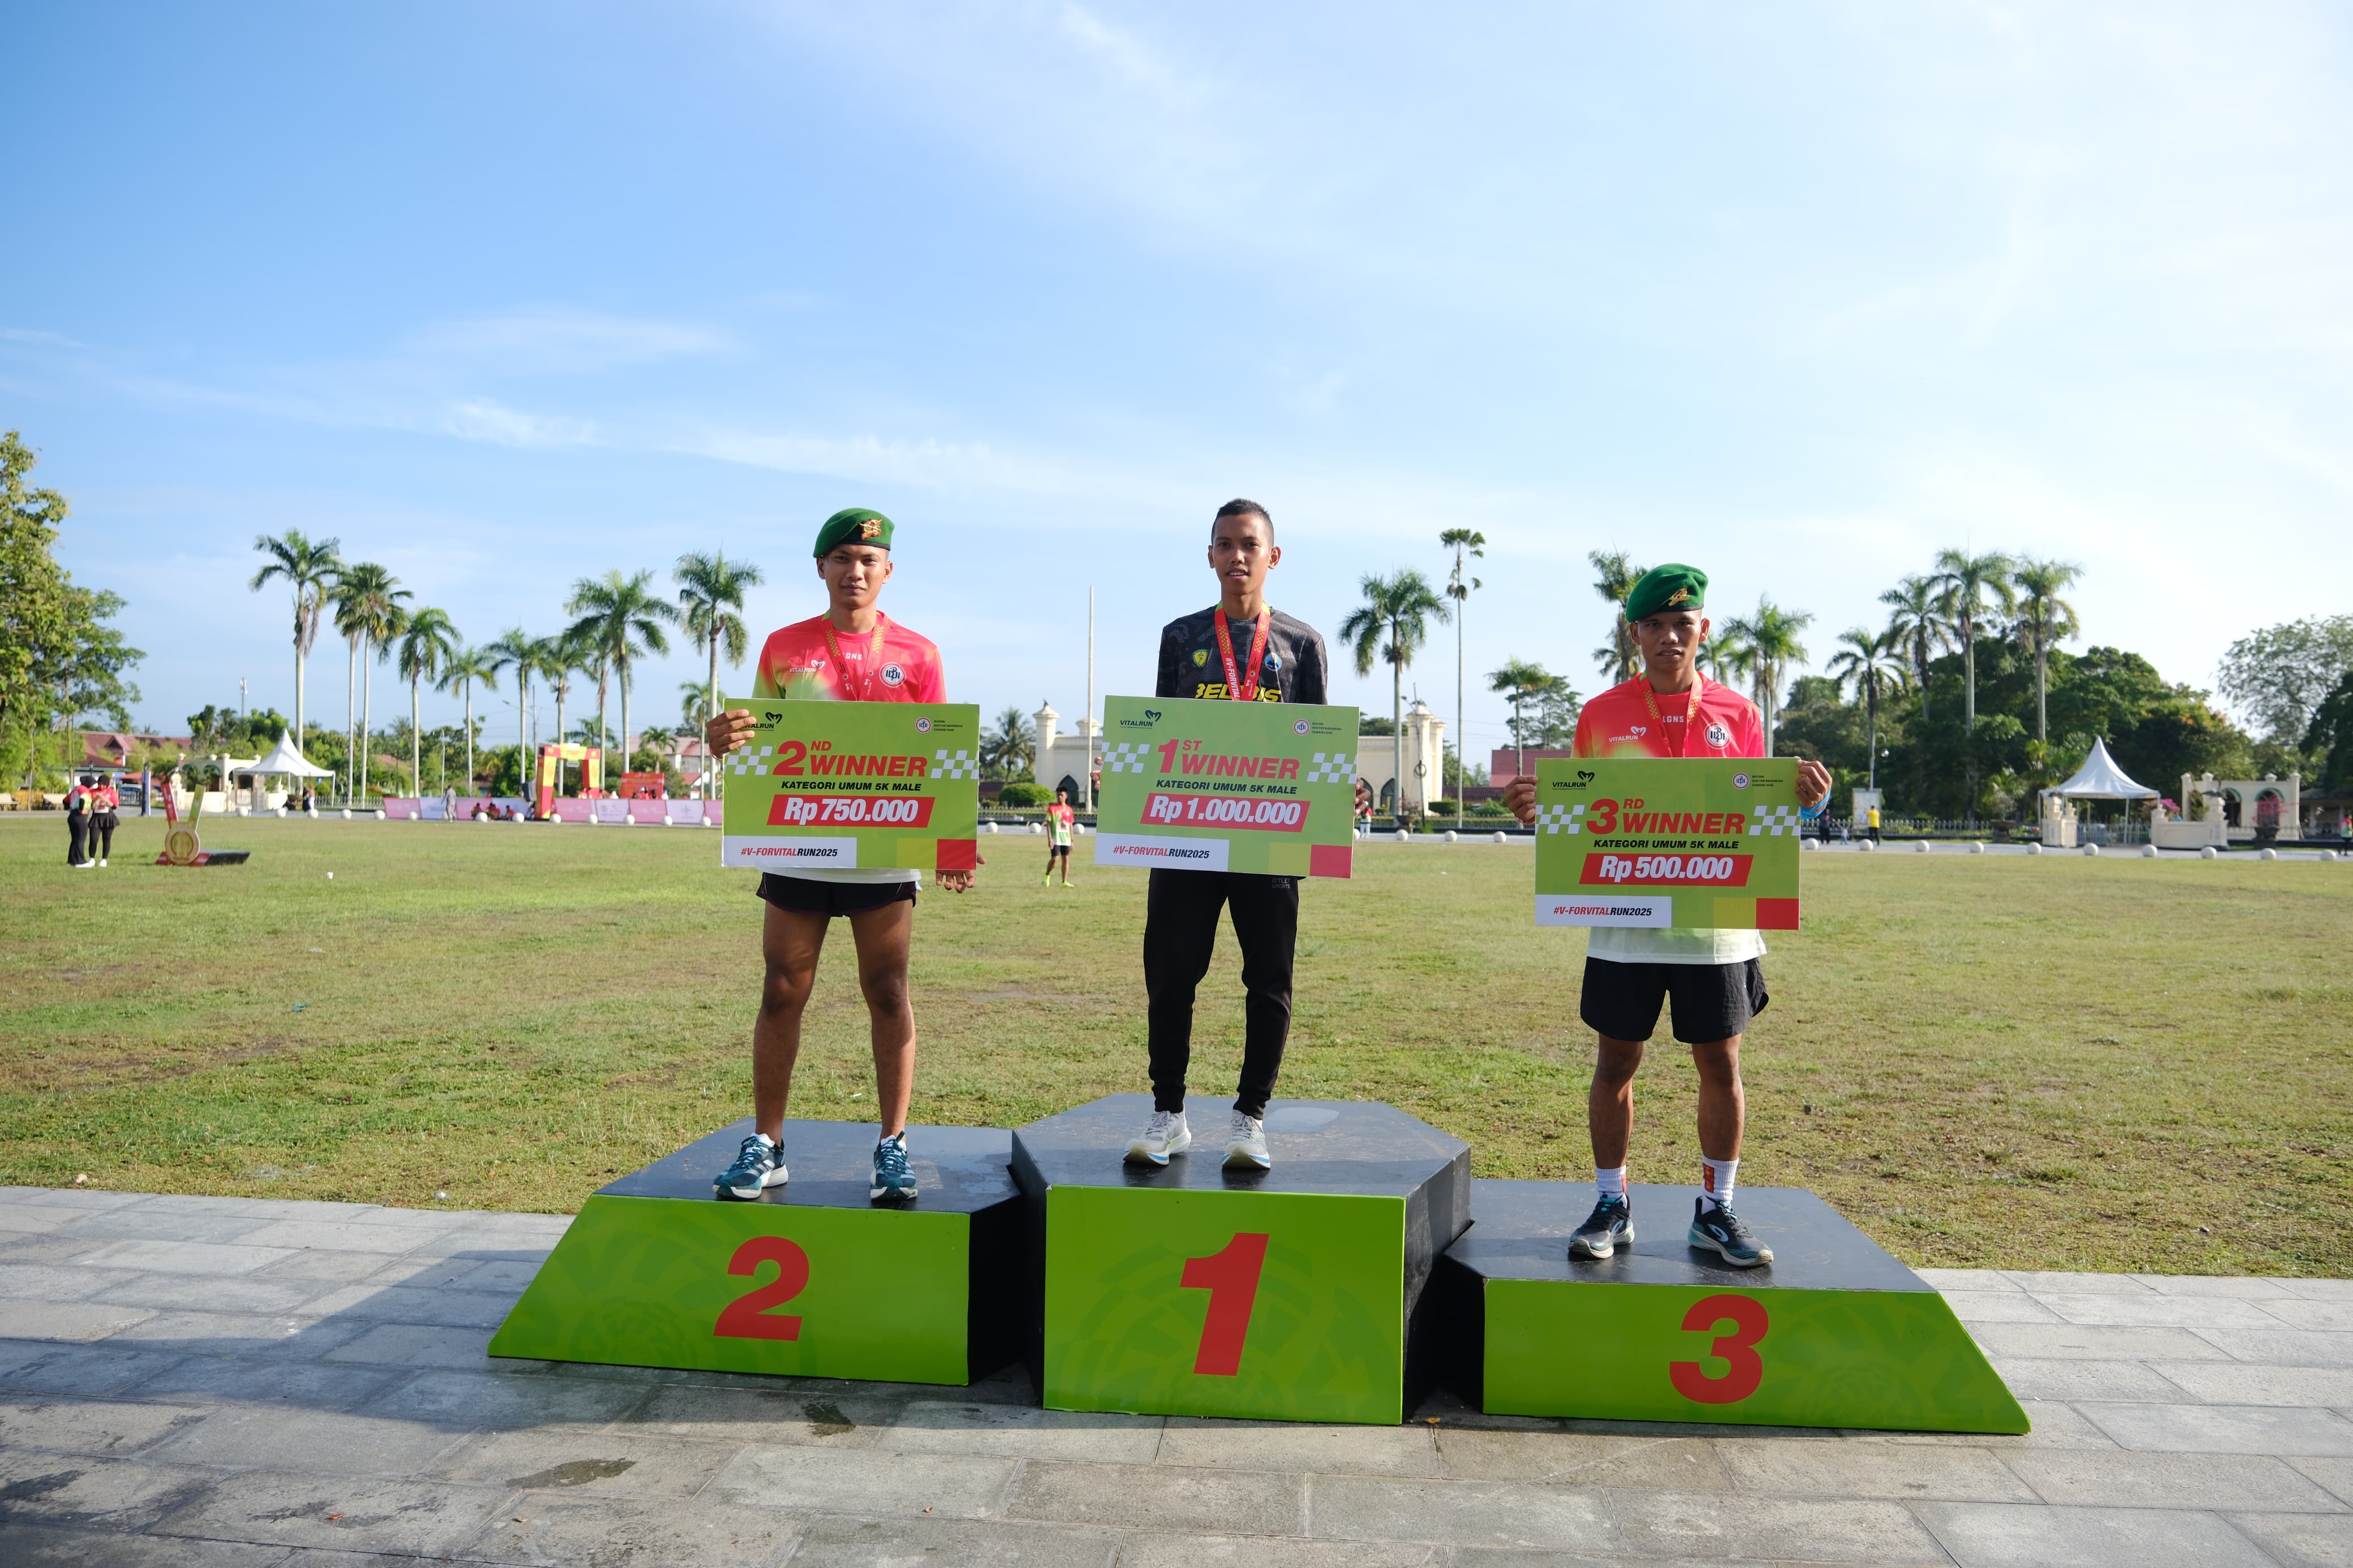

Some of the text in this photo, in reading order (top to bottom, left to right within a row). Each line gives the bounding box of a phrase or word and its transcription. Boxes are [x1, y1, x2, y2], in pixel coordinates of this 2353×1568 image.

[842, 652, 863, 660] GNS
[811, 740, 832, 751] ND
[1183, 740, 1203, 751] ST
[810, 754, 928, 777] WINNER
[1182, 753, 1300, 780] WINNER
[781, 781, 836, 790] KATEGORI
[838, 782, 872, 791] UMUM
[1156, 780, 1210, 790] KATEGORI
[1213, 783, 1247, 792] UMUM
[1267, 785, 1298, 794] MALE
[1149, 795, 1301, 825] Rp 1.000.000
[1623, 798, 1645, 810] RD
[784, 797, 919, 826] Rp 750.000
[1623, 812, 1746, 835] WINNER
[1593, 839, 1739, 849] KATEGORI UMUM 5K MALE
[741, 847, 838, 857] #V-FORVITALRUN2025
[1113, 846, 1210, 859] #V-FORVITALRUN2025
[1599, 856, 1733, 883] Rp 500.000
[1553, 906, 1652, 917] #V-FORVITALRUN2025
[714, 1236, 809, 1341] 2
[1180, 1233, 1269, 1376] 1
[1670, 1294, 1769, 1404] 3
